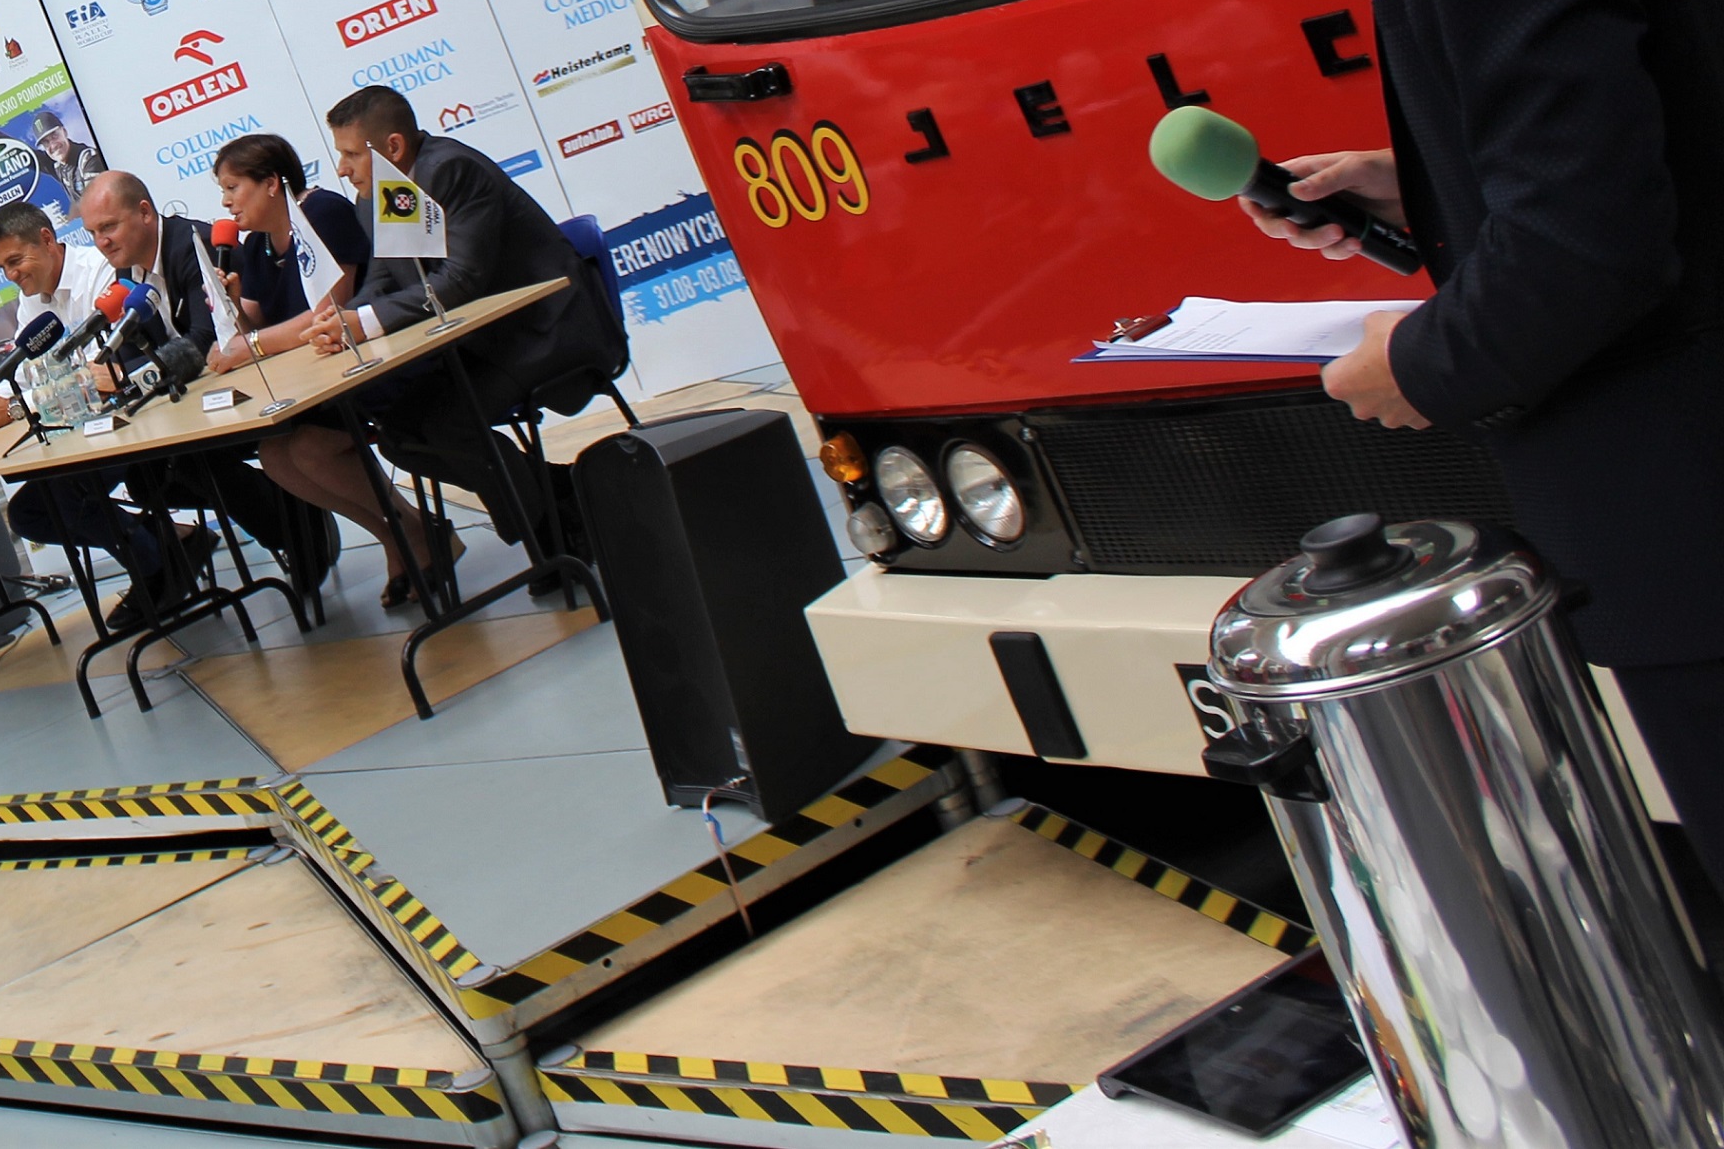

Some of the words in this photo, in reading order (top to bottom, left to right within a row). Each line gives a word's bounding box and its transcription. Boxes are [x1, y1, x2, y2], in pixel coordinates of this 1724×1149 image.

[352, 38, 456, 89] COLUMNA
[550, 43, 632, 80] Heisterkamp
[905, 8, 1373, 165] JELC
[17, 70, 67, 106] POMORSKIE
[151, 68, 241, 118] ORLEN
[156, 114, 263, 165] COLUMNA
[630, 104, 672, 127] WRC
[734, 125, 870, 229] 809
[610, 210, 726, 277] ERENOWYCH
